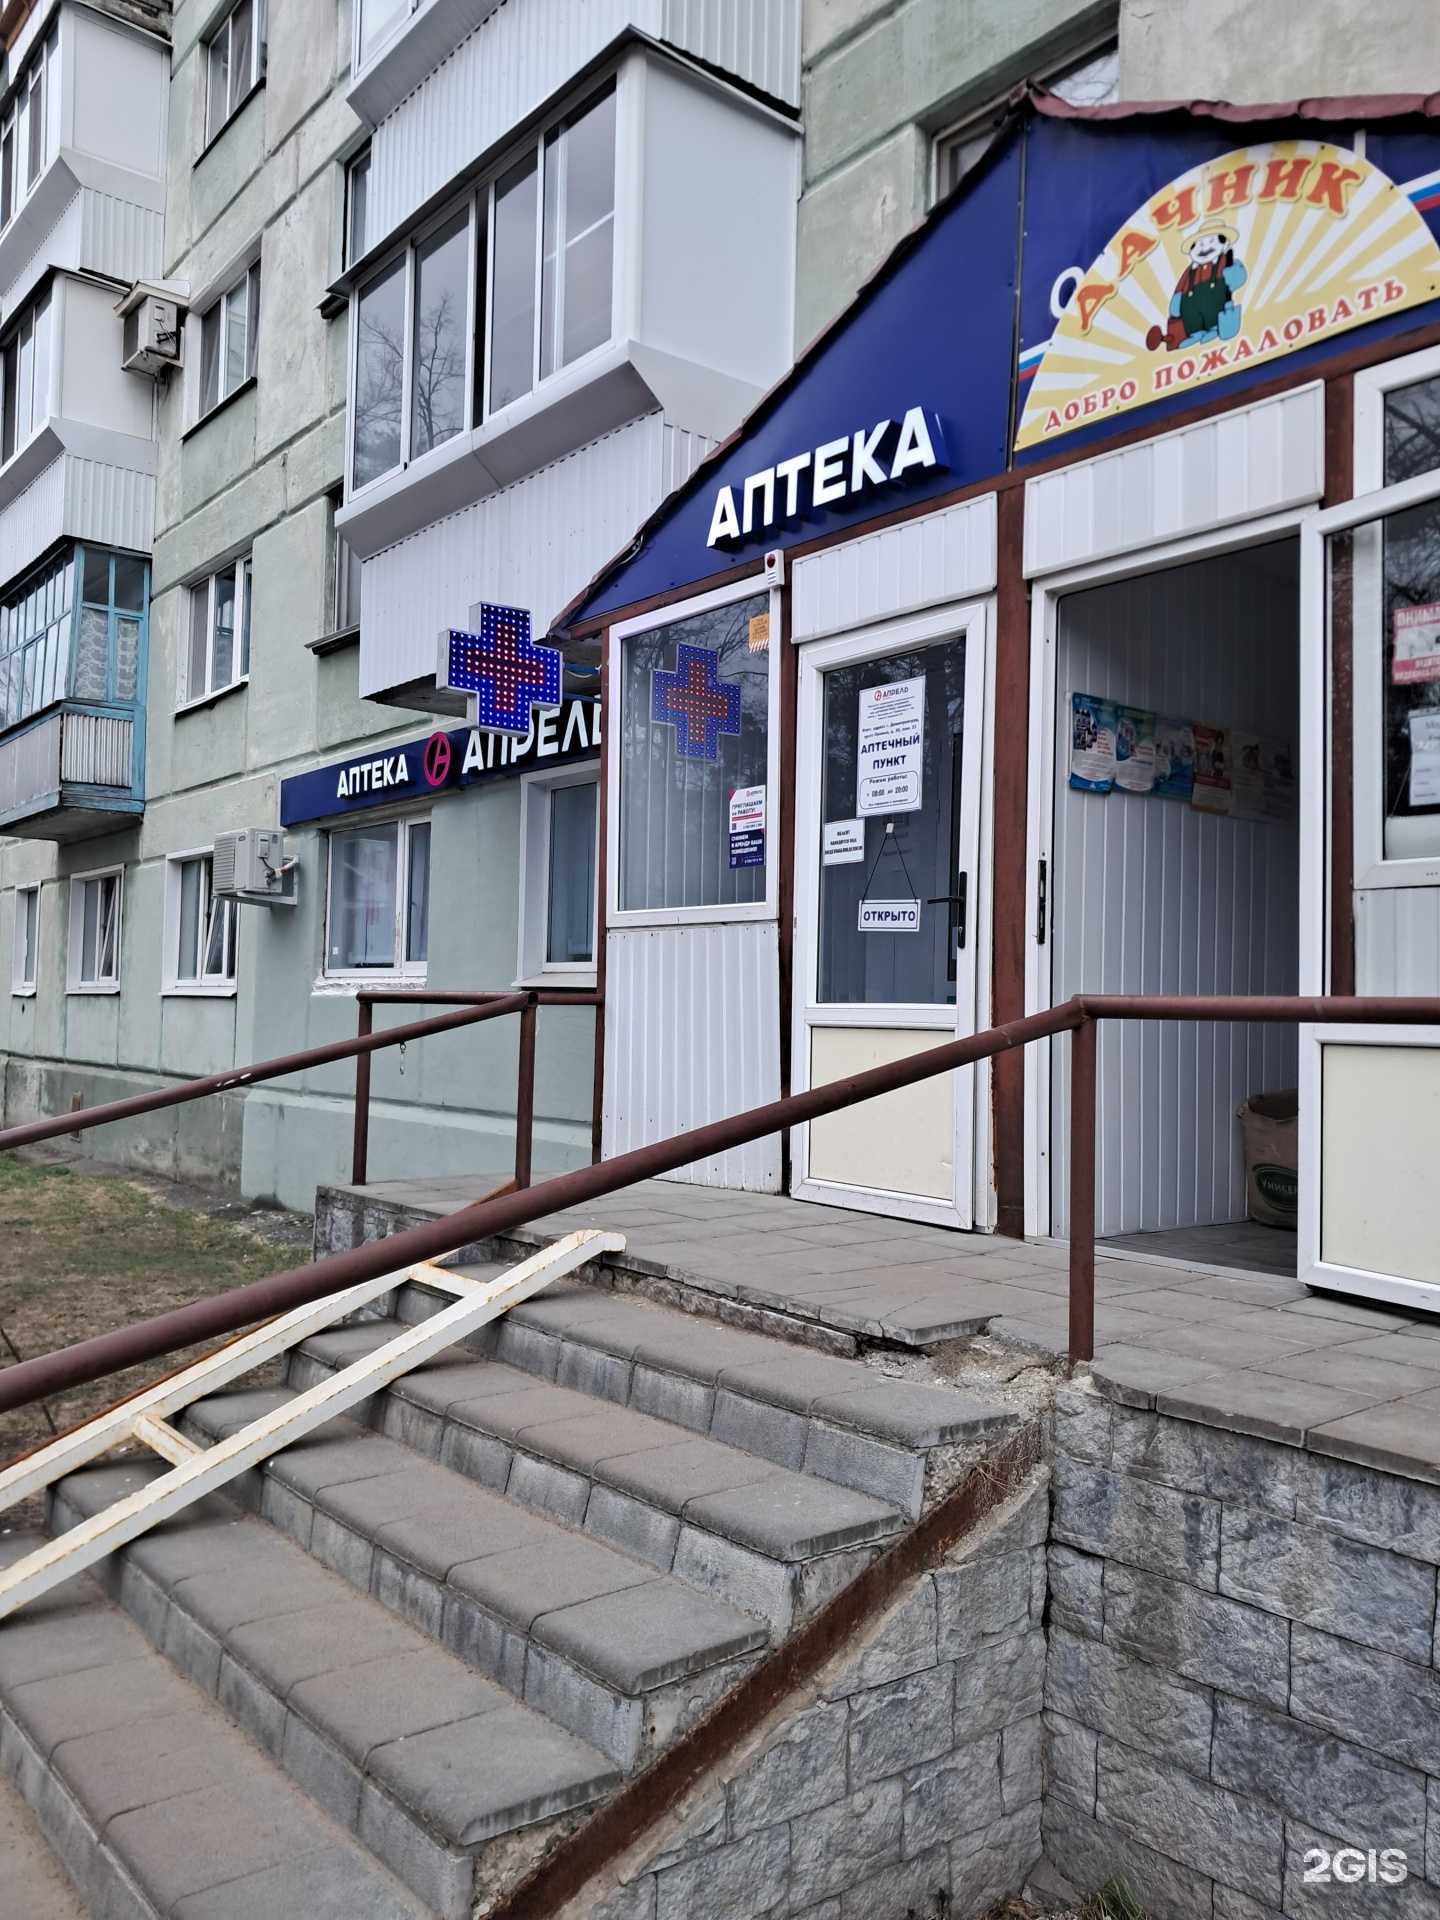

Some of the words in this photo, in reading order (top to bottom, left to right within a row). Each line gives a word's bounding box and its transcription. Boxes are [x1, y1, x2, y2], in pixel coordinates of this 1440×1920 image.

[1074, 157, 1362, 333] ДАЧНИК
[1044, 379, 1137, 433] ДОБРО
[1153, 279, 1405, 390] ПОЖАЛОВАТЬ
[706, 405, 937, 548] АПТЕКА
[861, 732, 920, 754] АПТЕЧНЫЙ
[872, 754, 907, 769] ПУНКТ
[336, 753, 409, 798] АПТЕКА
[863, 910, 916, 922] ОТКРЫТО
